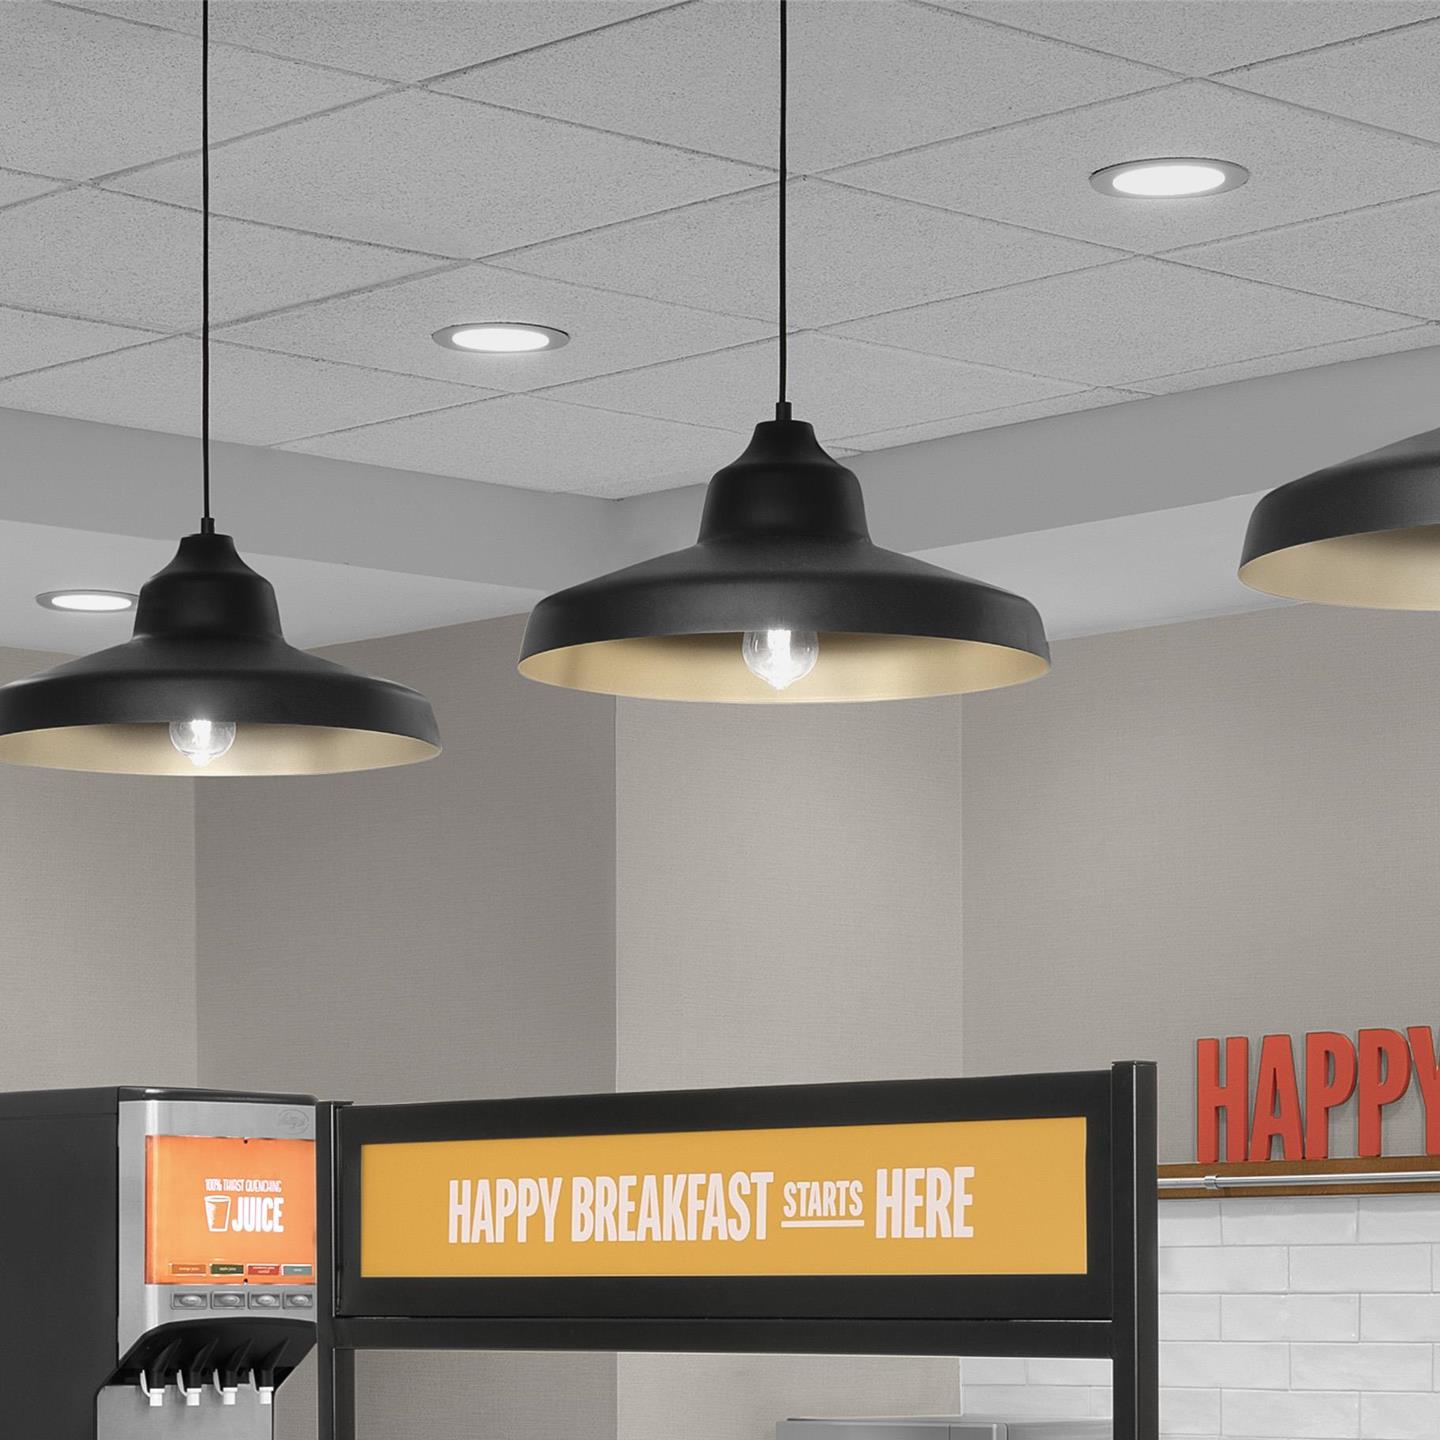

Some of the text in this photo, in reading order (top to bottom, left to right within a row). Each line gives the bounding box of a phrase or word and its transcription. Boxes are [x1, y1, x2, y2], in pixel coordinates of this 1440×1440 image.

[231, 1196, 285, 1233] JUICE
[448, 1166, 975, 1244] HAPPY BREAKFAST STARTS HERE
